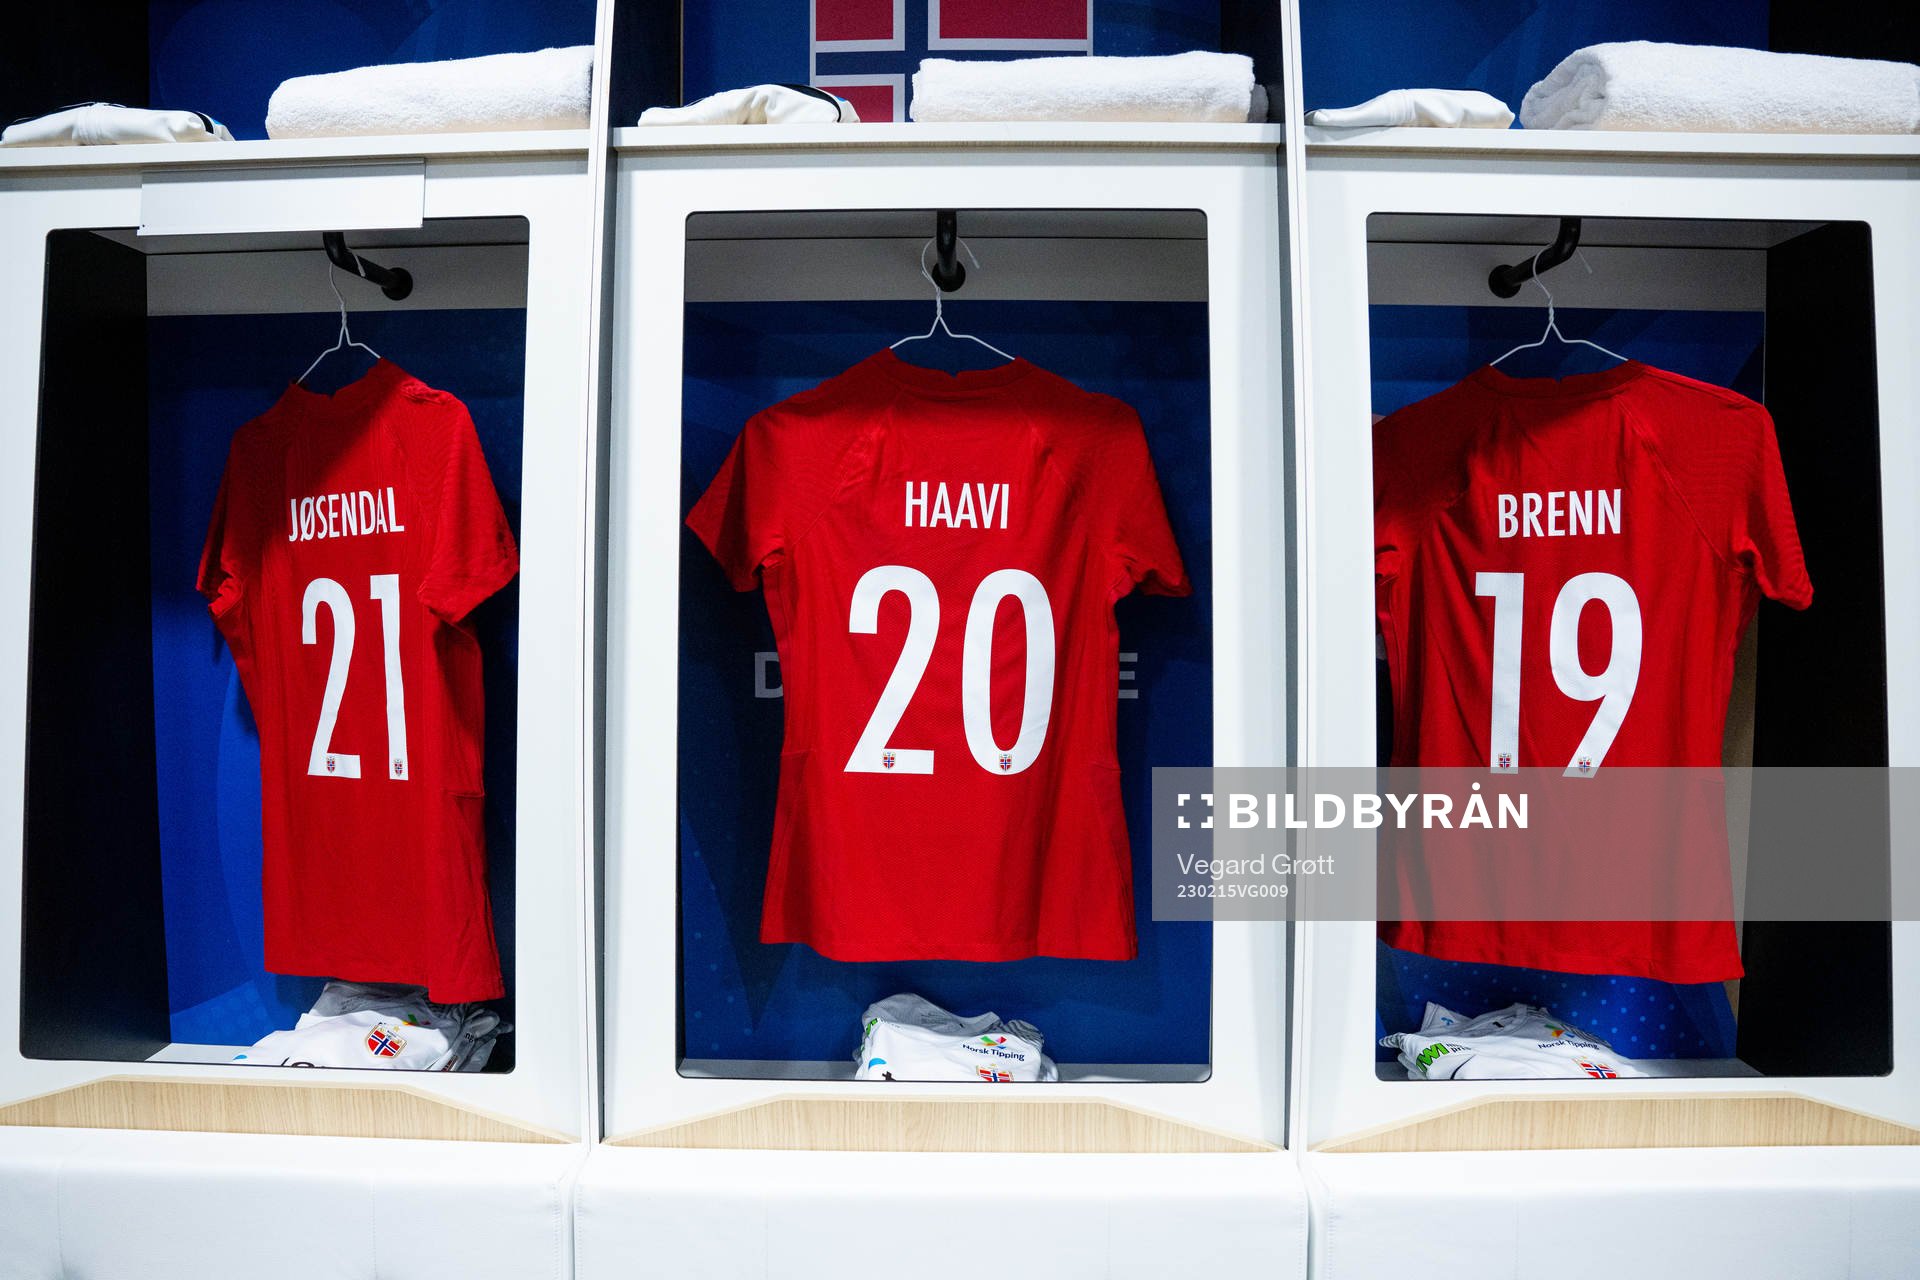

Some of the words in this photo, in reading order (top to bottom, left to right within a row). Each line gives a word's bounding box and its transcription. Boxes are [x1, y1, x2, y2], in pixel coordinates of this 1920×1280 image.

[288, 486, 405, 542] JØSENDAL
[904, 481, 1010, 530] HAAVI
[1498, 488, 1622, 539] BRENN
[301, 573, 409, 781] 21
[843, 564, 1056, 776] 20
[1474, 571, 1643, 779] 19
[962, 1043, 989, 1055] Norsk
[990, 1048, 1025, 1062] Tipping
[1538, 1040, 1564, 1049] Norsk
[1565, 1040, 1600, 1051] Tipping
